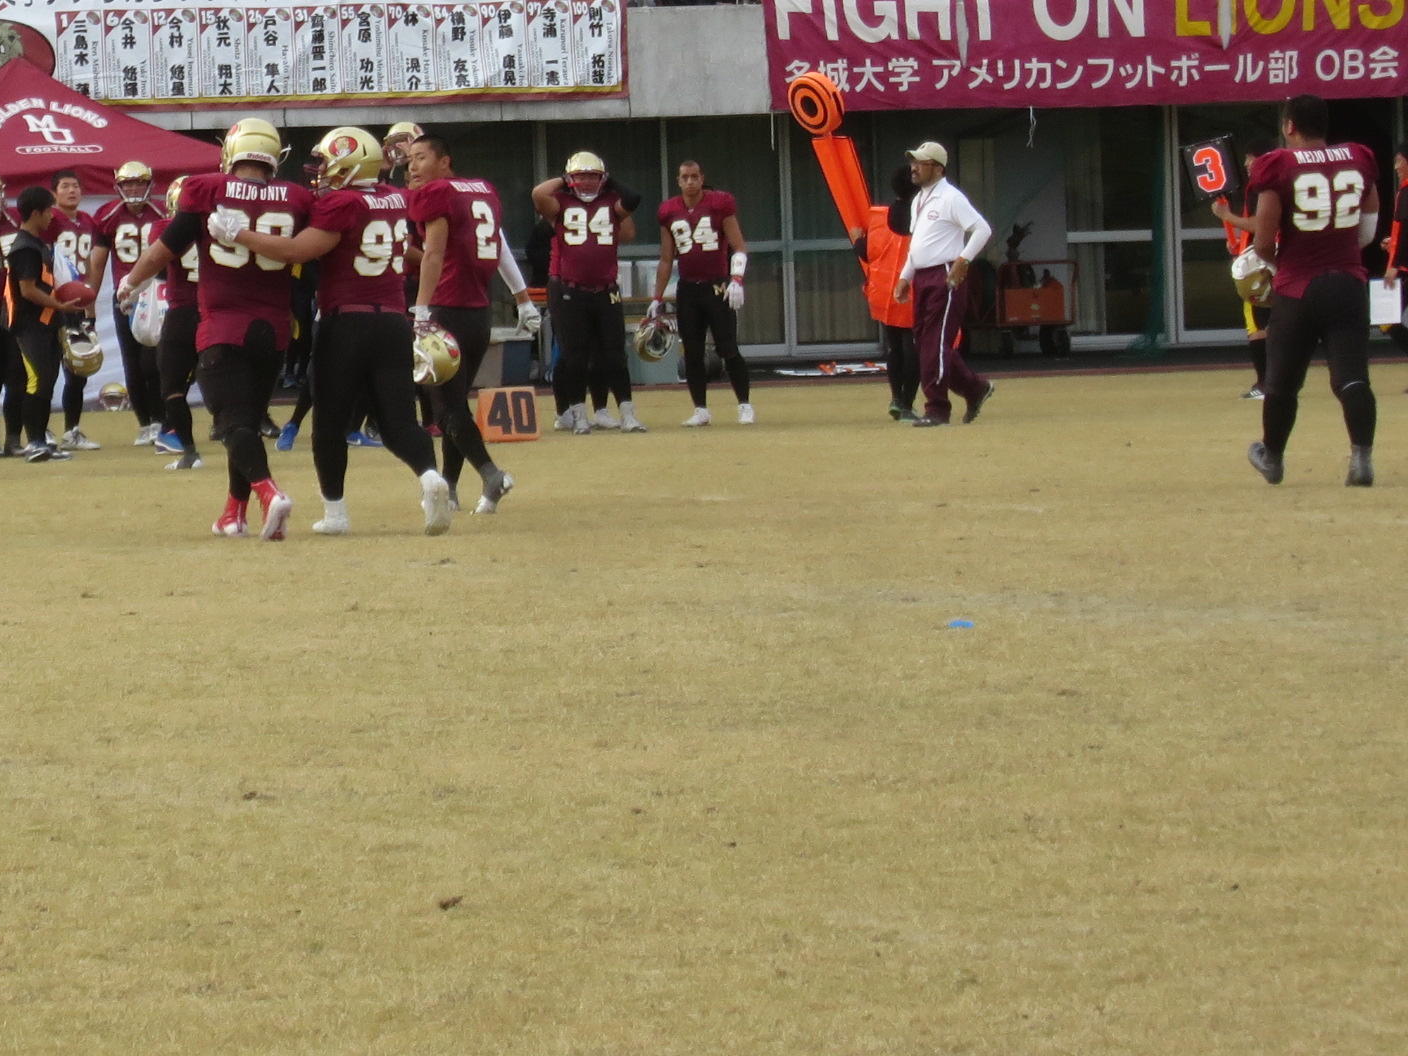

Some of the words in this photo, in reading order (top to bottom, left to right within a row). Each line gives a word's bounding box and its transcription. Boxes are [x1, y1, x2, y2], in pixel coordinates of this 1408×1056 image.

[106, 13, 120, 27] 6
[153, 10, 167, 26] 12
[201, 9, 215, 25] 15
[247, 9, 263, 24] 26
[294, 8, 308, 23] 31
[342, 7, 355, 20] 55
[388, 7, 403, 19] 70
[403, 11, 419, 27] 林
[480, 5, 496, 18] 90
[527, 2, 542, 17] 97
[542, 7, 558, 39] 寺浦
[572, 1, 588, 16] 100
[588, 6, 604, 38] 則竹
[122, 18, 137, 50] 今井
[168, 16, 184, 49] 今村
[215, 15, 231, 48] 秋元
[264, 15, 279, 47] 戸谷
[357, 11, 372, 43] 宮原
[497, 9, 514, 39] 伊藤
[73, 19, 90, 67] 三島木
[217, 64, 233, 95] 翔太
[932, 50, 1298, 90] アメリカンフットボール部
[1315, 45, 1399, 82] OB会
[49, 101, 109, 129] LIONS
[25, 144, 95, 154] FOOTBALL
[1293, 150, 1326, 164] MEIJO
[1192, 146, 1227, 193] 3
[225, 181, 257, 201] MEIJO
[259, 185, 288, 202] UNIV.
[1293, 170, 1365, 232] 92
[471, 200, 498, 260] 2
[563, 206, 614, 246] 94
[670, 216, 719, 255] 84
[487, 391, 537, 435] 40
